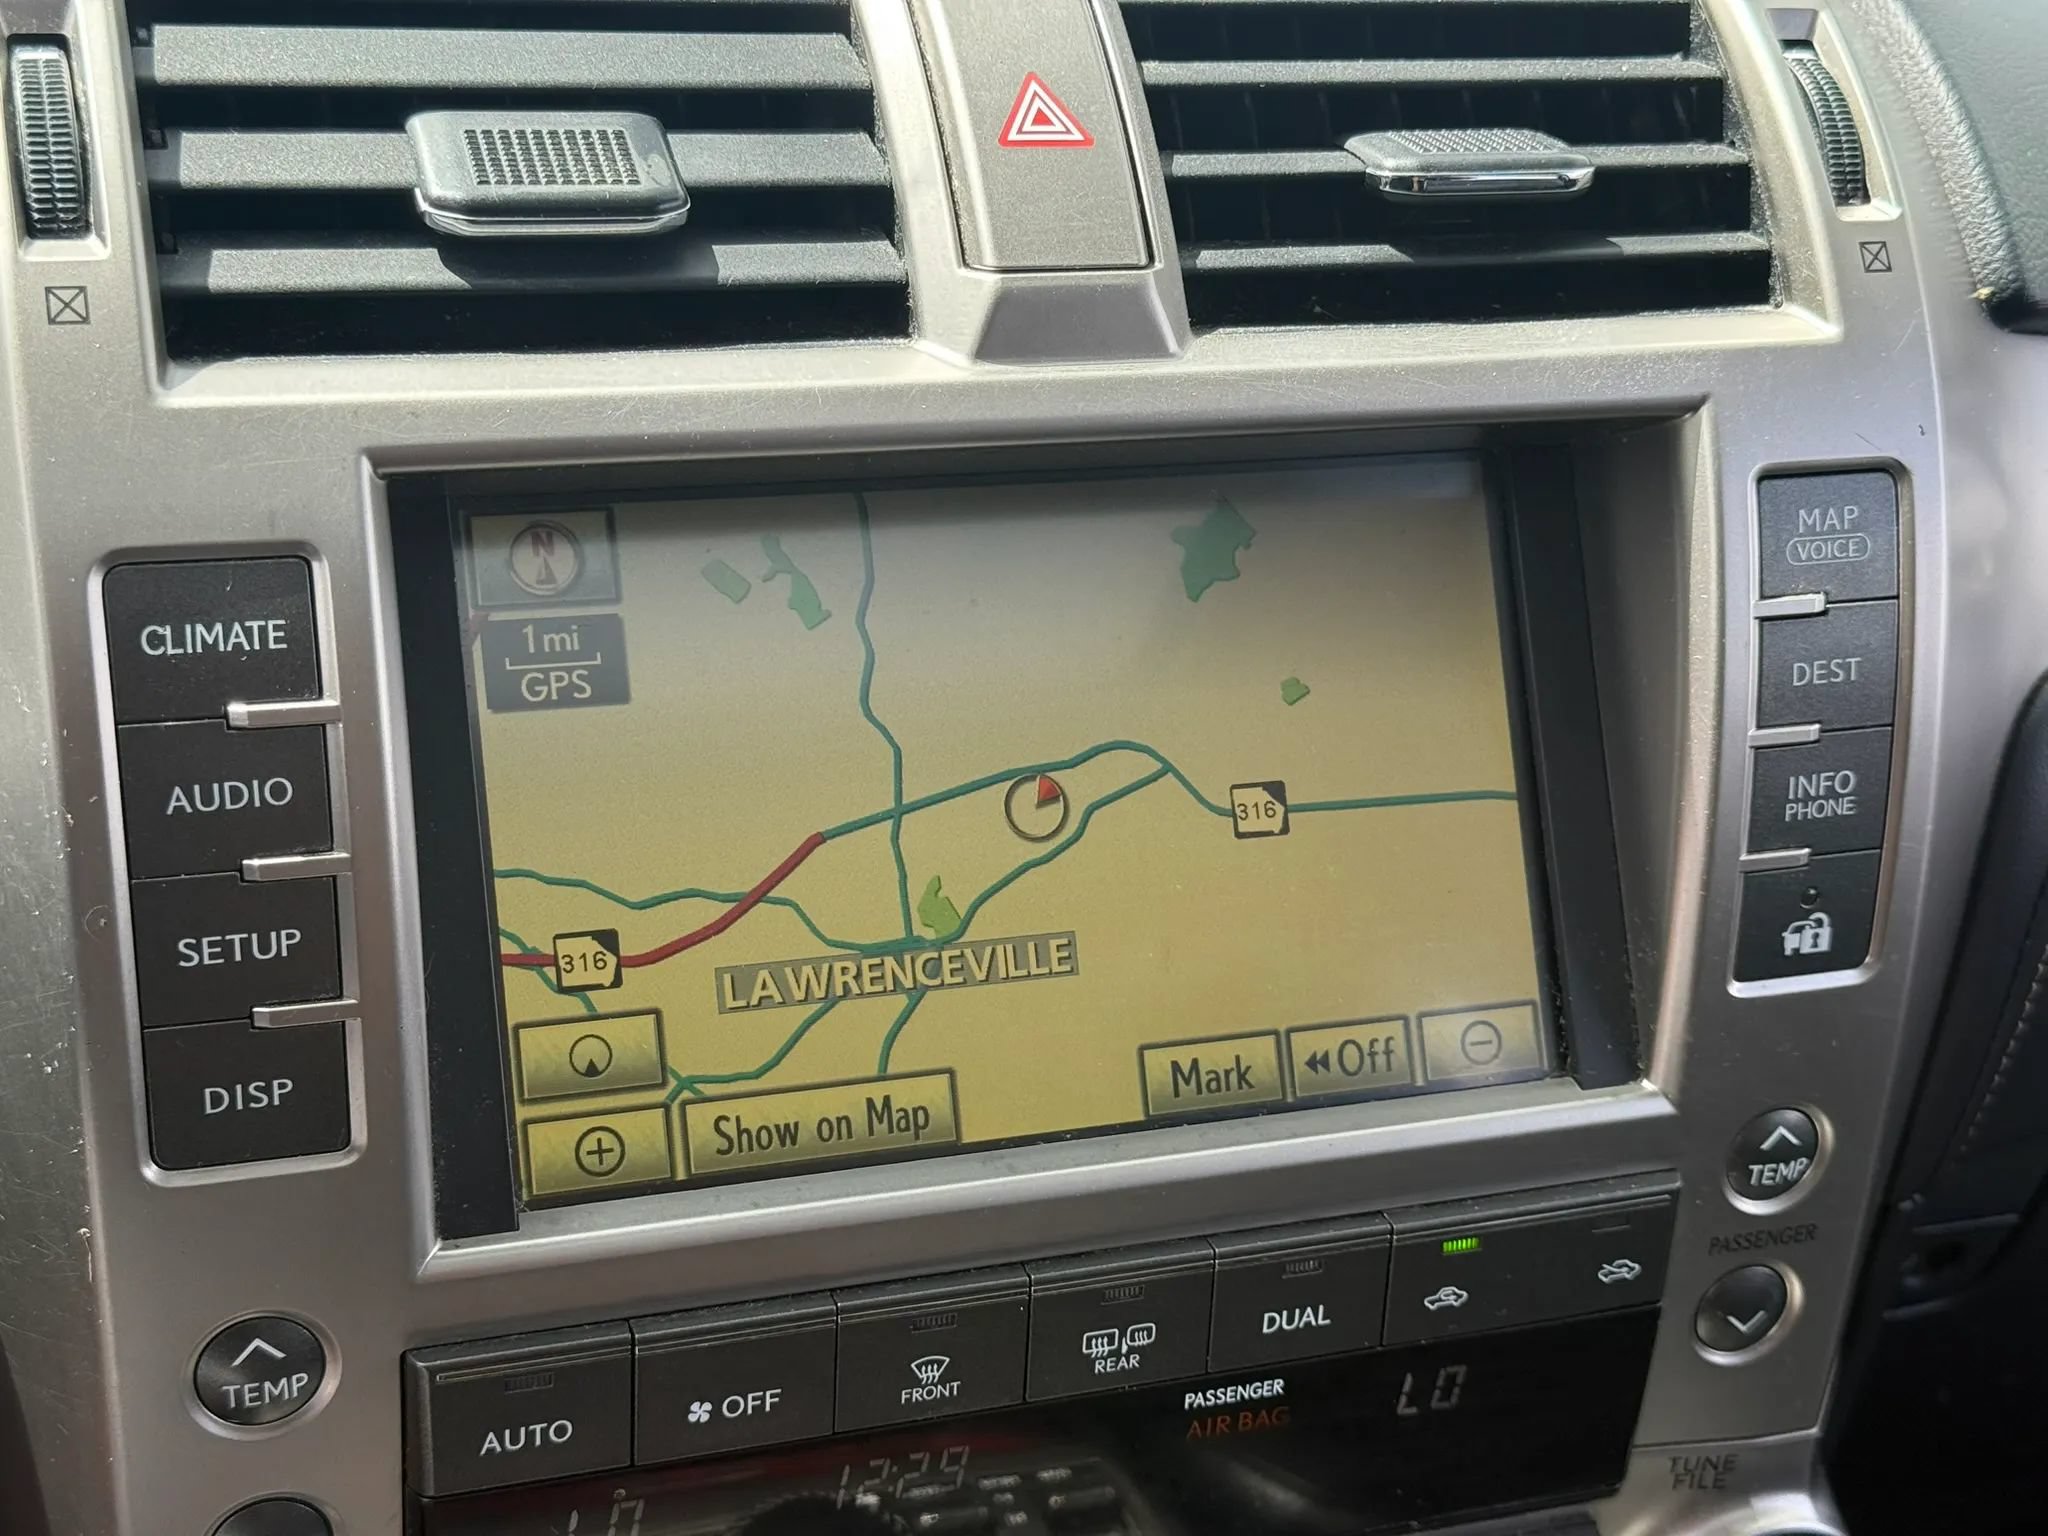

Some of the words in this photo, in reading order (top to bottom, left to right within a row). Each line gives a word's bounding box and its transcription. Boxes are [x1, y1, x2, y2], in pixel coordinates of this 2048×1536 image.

[1799, 505, 1859, 531] MAP
[1795, 538, 1862, 560] VOICE
[139, 620, 288, 656] CLIMATE
[520, 669, 593, 703] GPS
[1792, 658, 1862, 686] DEST
[165, 776, 294, 816] AUDIO
[1787, 769, 1857, 799] INFO
[1237, 799, 1277, 823] 316
[1784, 797, 1857, 822] PHONE
[177, 928, 302, 968] SETUP
[561, 950, 608, 975] 316
[722, 937, 1073, 1010] LAWRENCEVILLE
[1337, 1036, 1395, 1077] Off
[1169, 1053, 1256, 1098] Mark
[203, 1078, 295, 1116] DISP
[713, 1114, 800, 1156] Show
[815, 1119, 853, 1144] on
[864, 1096, 931, 1142] Map
[1748, 1157, 1809, 1187] TEMP
[1709, 1223, 1816, 1256] PASSENGER
[1262, 1304, 1331, 1334] DUAL
[1094, 1353, 1140, 1375] REAR
[221, 1372, 310, 1409] TEMP
[721, 1388, 783, 1419] OFF
[901, 1380, 961, 1405] FRONT
[1184, 1378, 1286, 1410] PASSENGER
[479, 1419, 574, 1457] AUTO
[1185, 1416, 1232, 1440] AIR
[1238, 1406, 1291, 1434] BAG
[1668, 1453, 1738, 1475] TUNE
[1671, 1473, 1728, 1491] FILE
